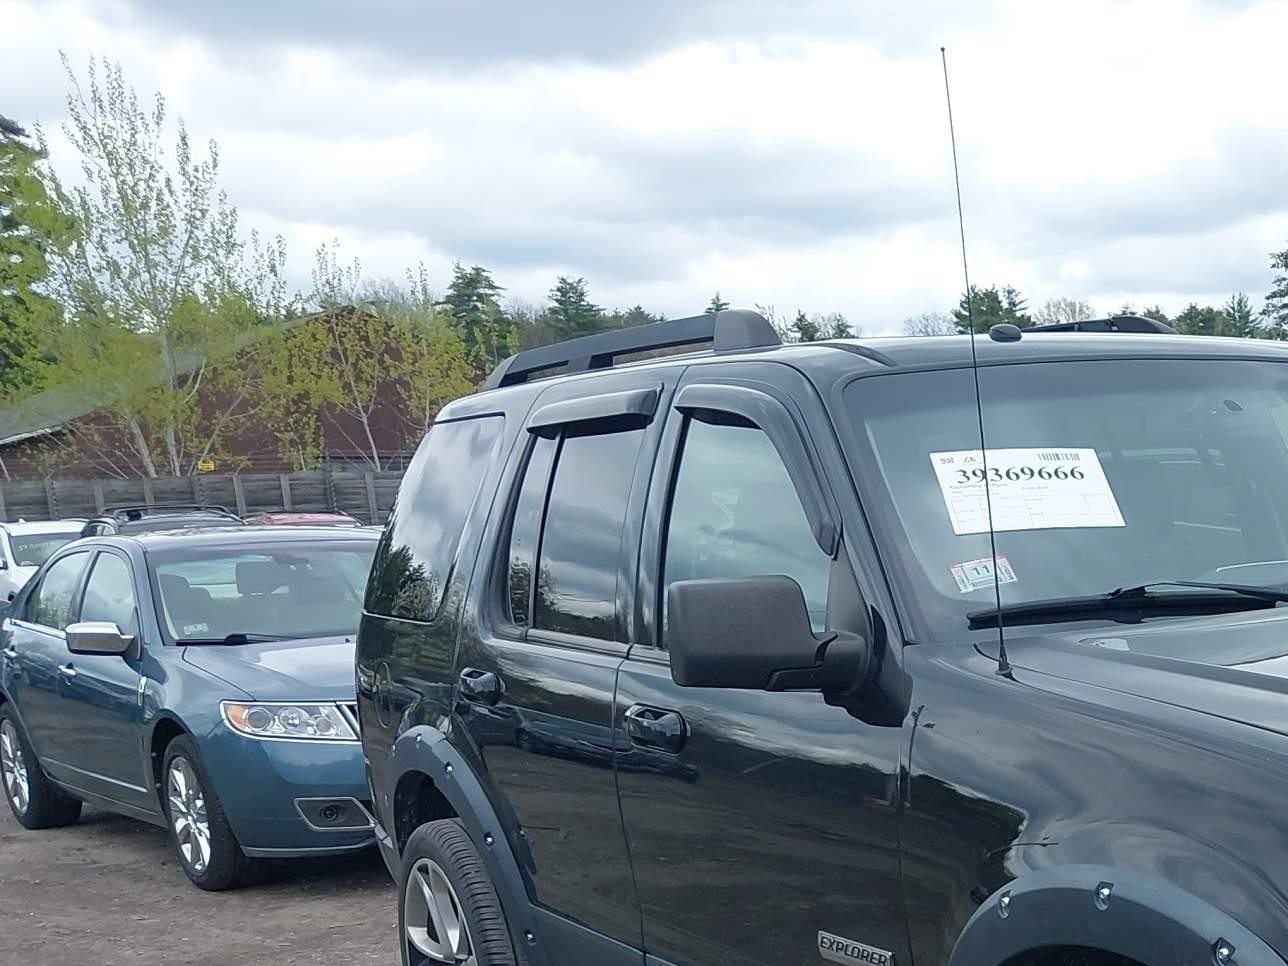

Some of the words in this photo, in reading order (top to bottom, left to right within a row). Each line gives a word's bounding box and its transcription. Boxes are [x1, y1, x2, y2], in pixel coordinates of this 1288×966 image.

[955, 465, 1085, 484] 39369666
[972, 565, 990, 576] 11
[820, 936, 888, 966] EXPLORER
